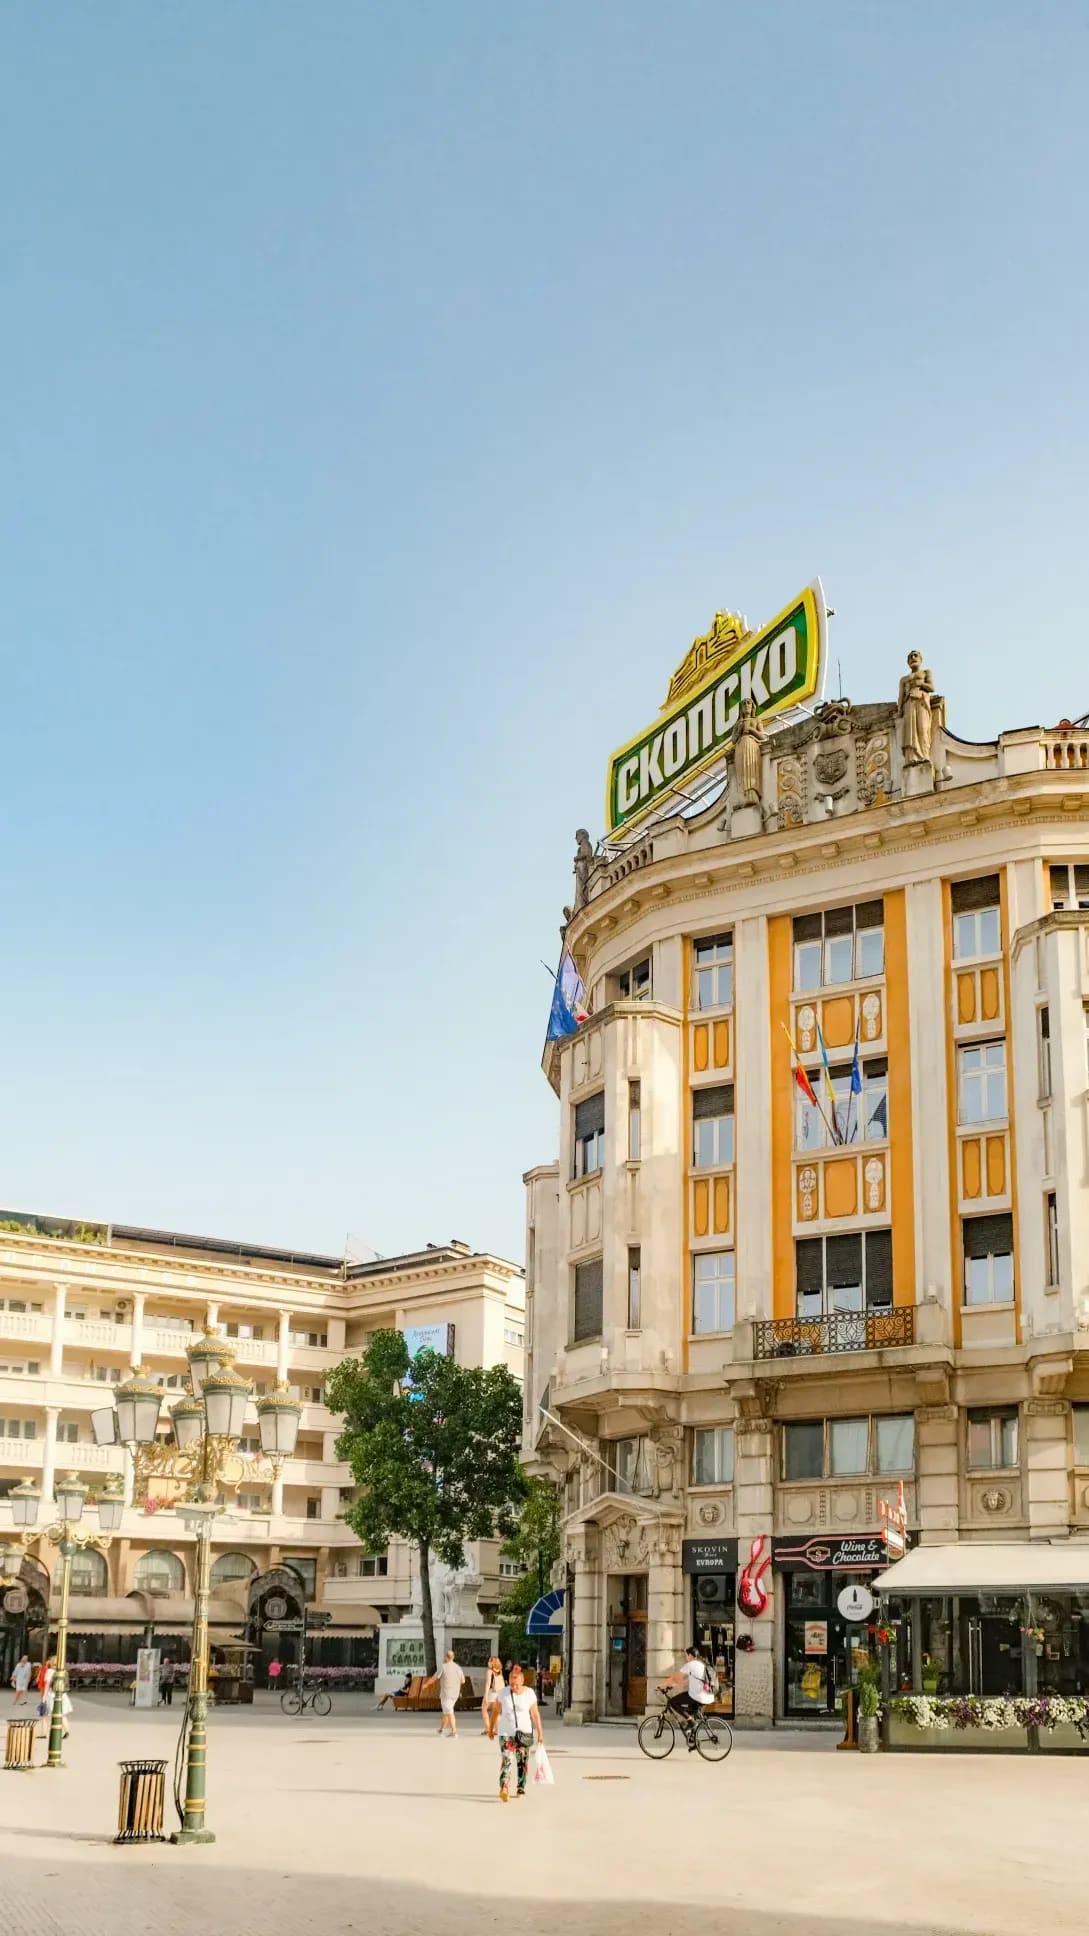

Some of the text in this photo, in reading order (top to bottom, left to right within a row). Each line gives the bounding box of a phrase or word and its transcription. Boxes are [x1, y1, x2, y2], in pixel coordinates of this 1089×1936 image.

[617, 626, 797, 814] СКОПСКО
[691, 1544, 728, 1554] SKOVIN
[841, 1540, 878, 1551] Wine &
[832, 1551, 880, 1565] Chocolate
[392, 1654, 425, 1665] САМОИ
